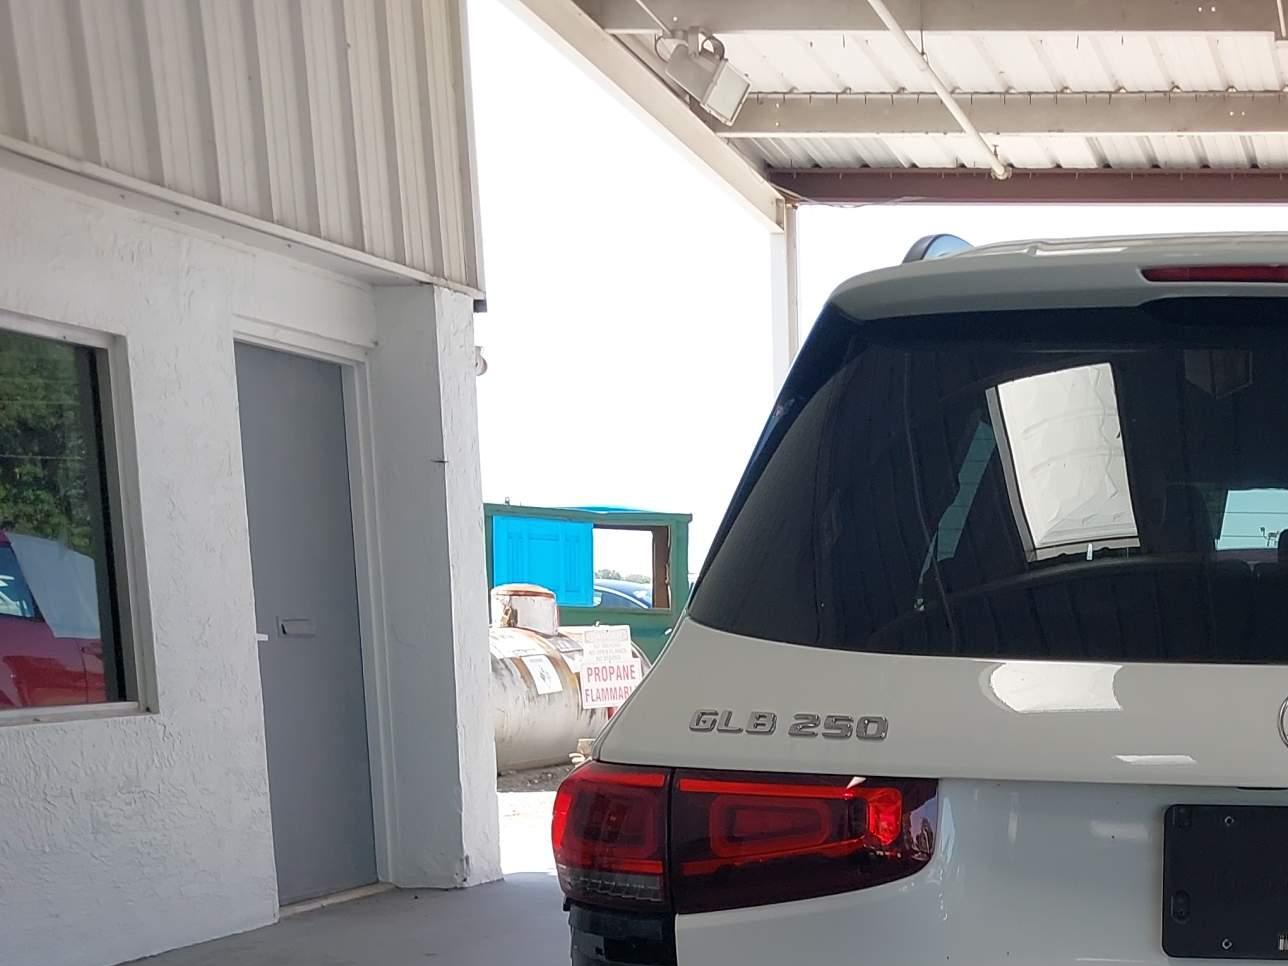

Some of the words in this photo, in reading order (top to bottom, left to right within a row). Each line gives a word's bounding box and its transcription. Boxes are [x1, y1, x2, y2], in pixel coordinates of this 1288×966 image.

[586, 664, 636, 682] PROPANE
[584, 685, 633, 702] FLAMMAB
[689, 709, 777, 736] GLB
[788, 713, 889, 740] 250
